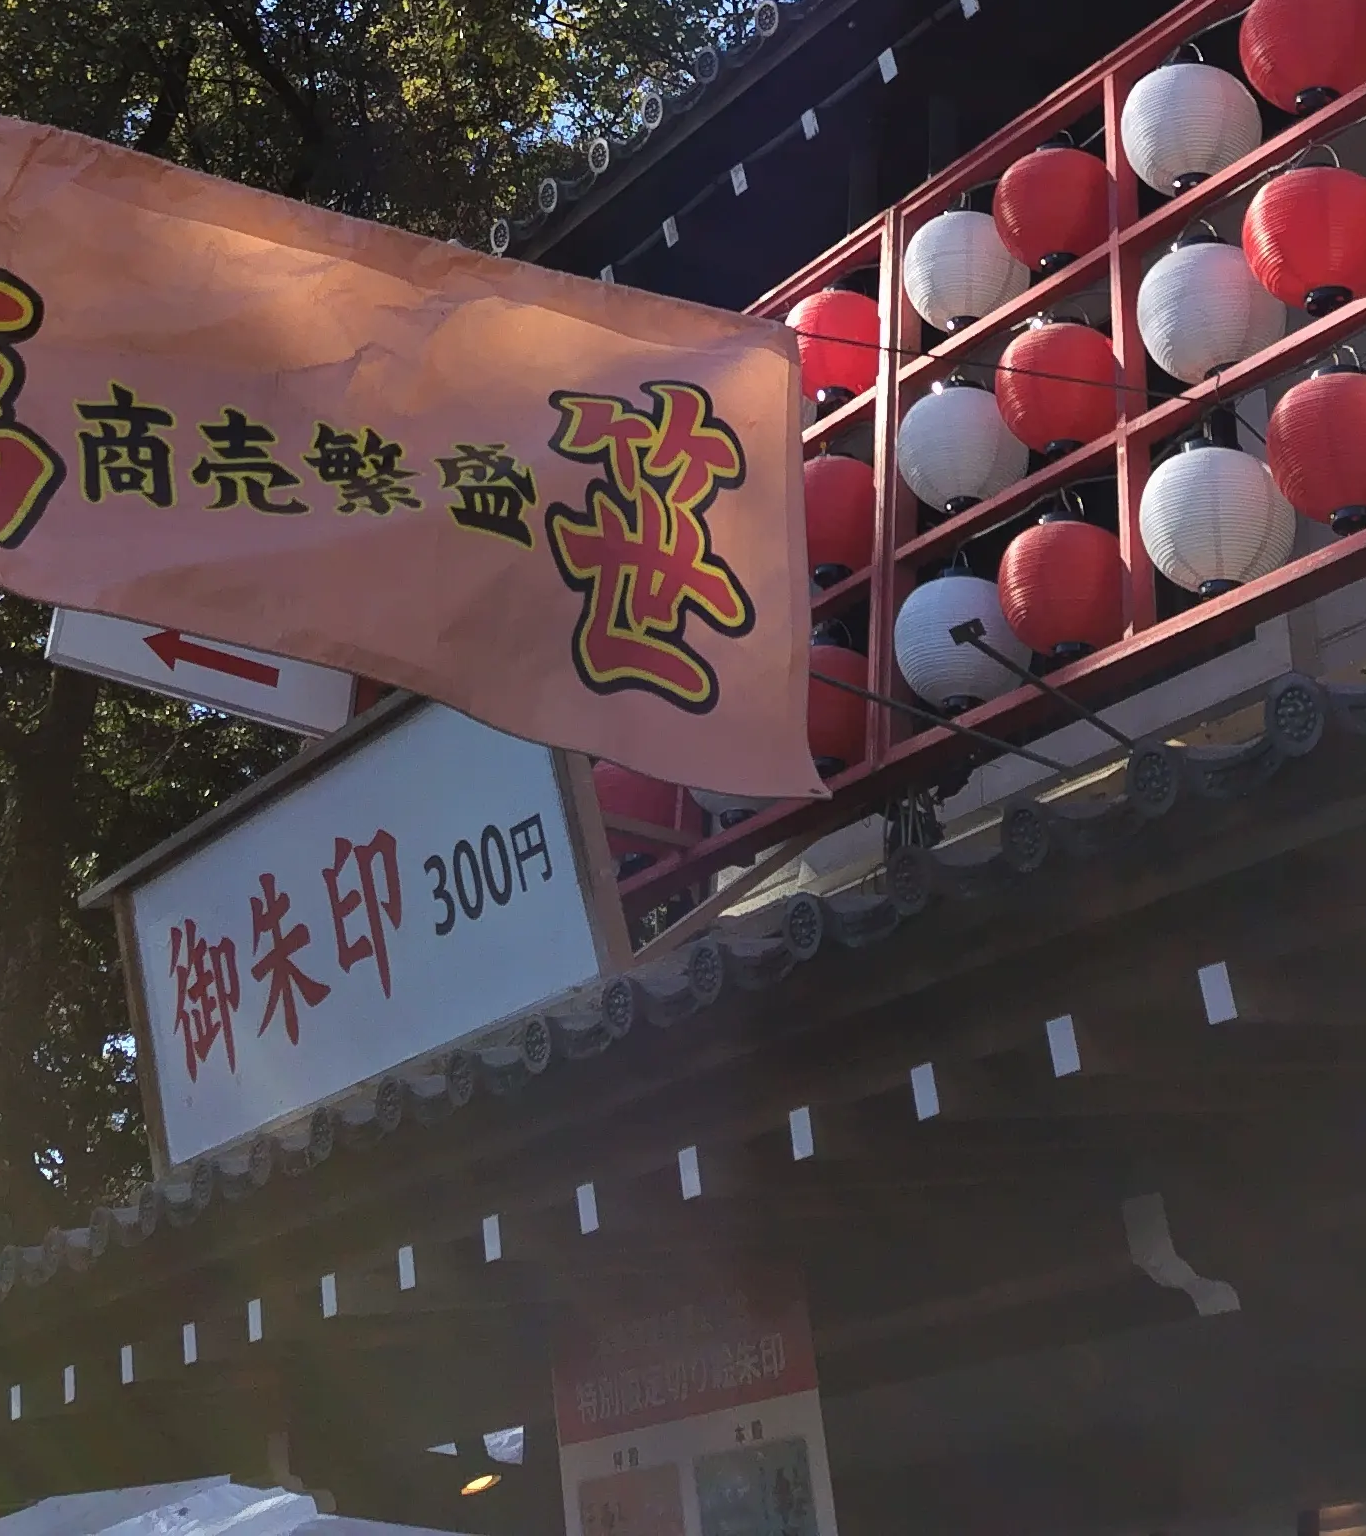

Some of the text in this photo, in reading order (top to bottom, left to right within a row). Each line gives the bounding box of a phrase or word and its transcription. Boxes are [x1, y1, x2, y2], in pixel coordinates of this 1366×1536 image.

[75, 382, 537, 548] 商売繁盛
[547, 380, 756, 713] 笹
[170, 813, 555, 1085] 御朱印 300円
